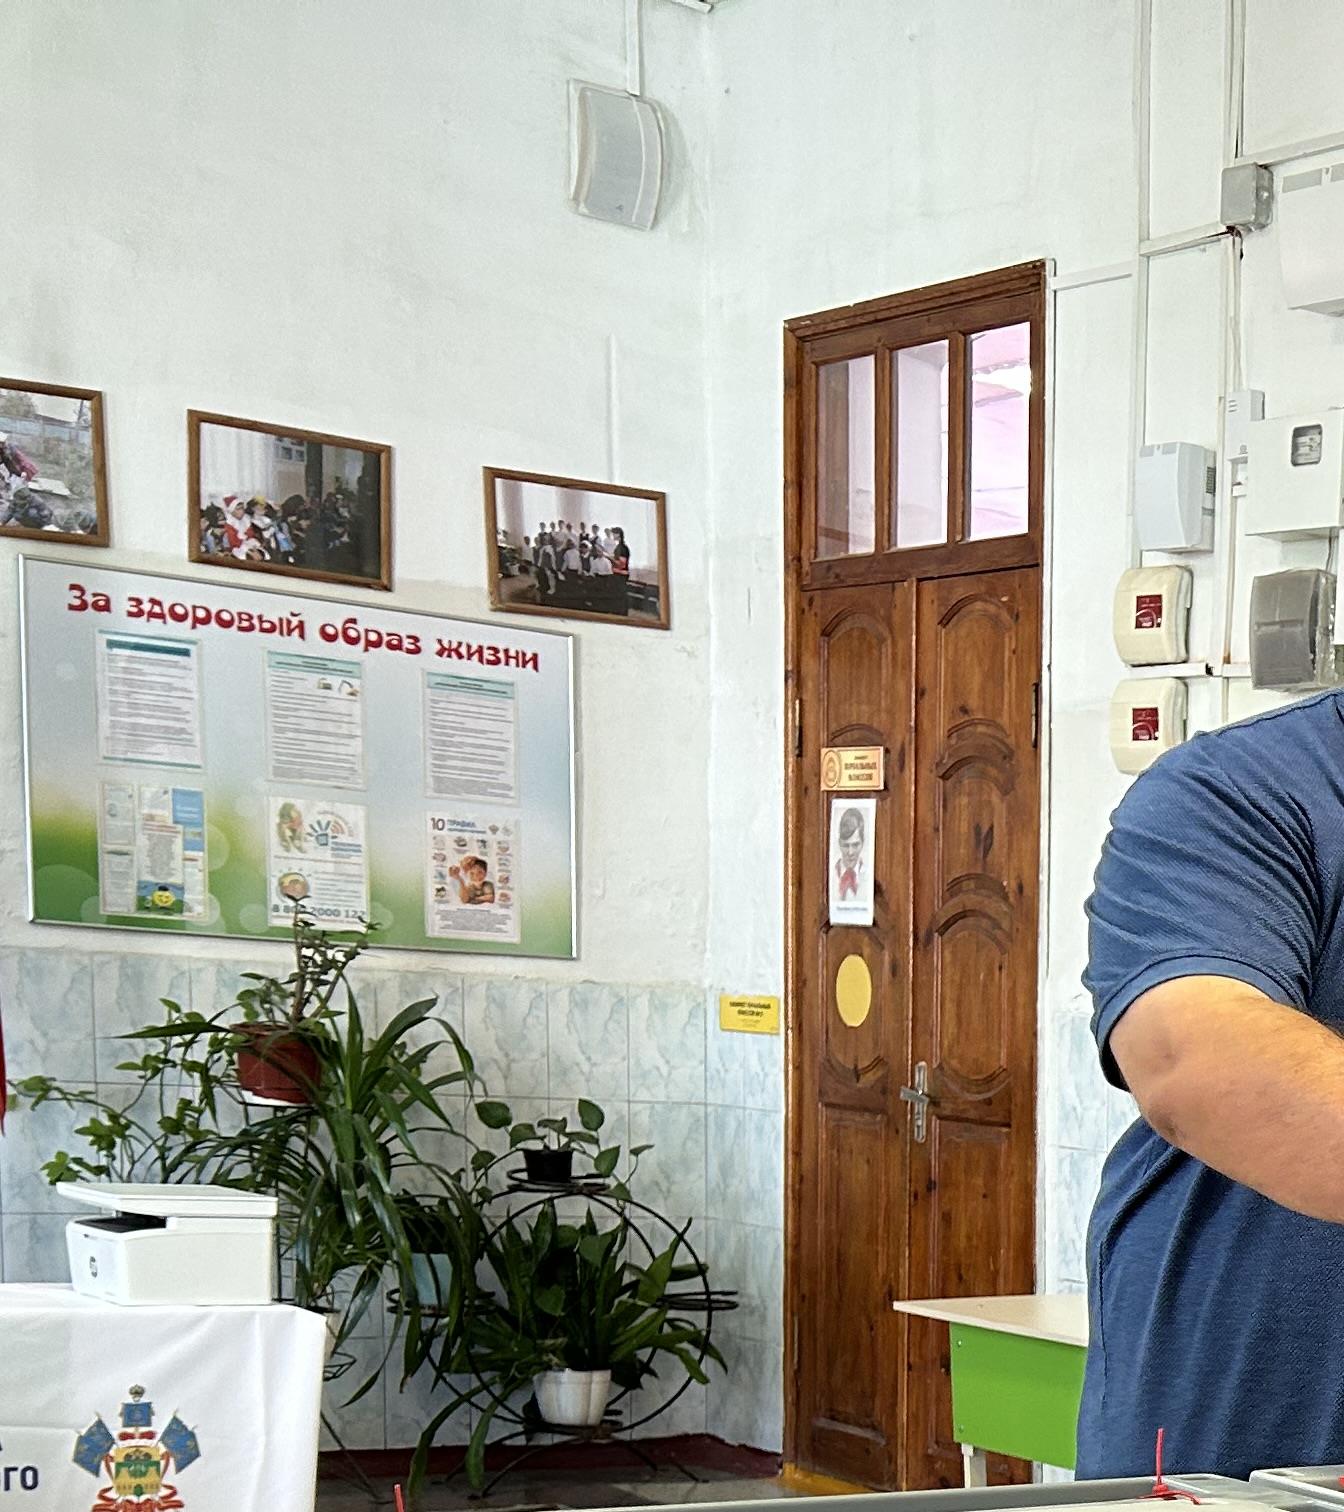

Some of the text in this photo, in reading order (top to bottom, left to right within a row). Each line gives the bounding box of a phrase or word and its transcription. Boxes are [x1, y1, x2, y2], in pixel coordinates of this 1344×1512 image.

[67, 583, 540, 673] За здоровый образ жизни
[430, 817, 446, 831] 10
